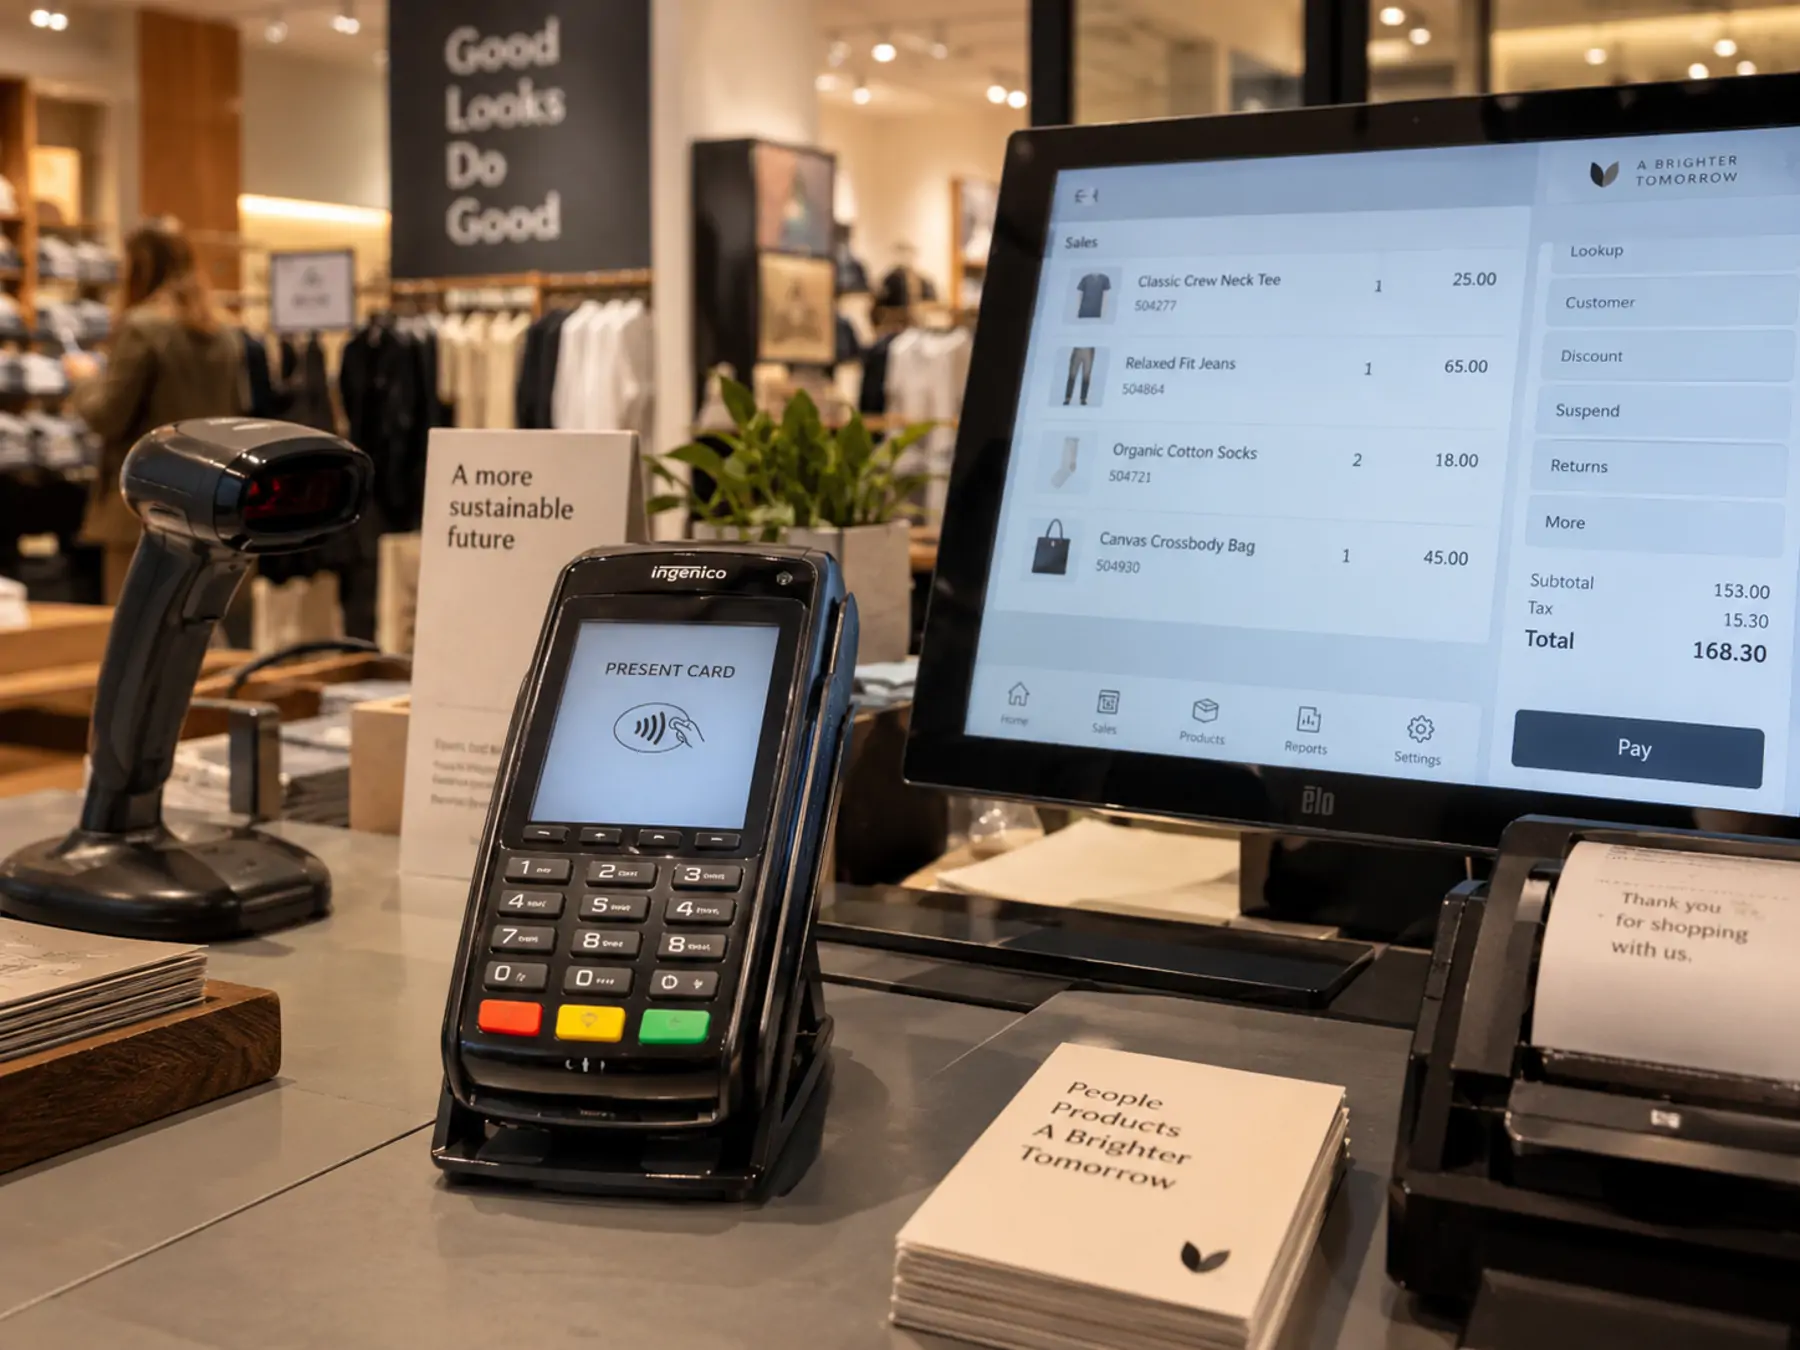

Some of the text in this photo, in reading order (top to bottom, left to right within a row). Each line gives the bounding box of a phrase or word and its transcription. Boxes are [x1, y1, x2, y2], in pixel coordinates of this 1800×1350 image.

[444, 15, 560, 76] Good
[446, 78, 567, 134] Looks
[446, 142, 507, 189] Do
[1636, 155, 1738, 170] A BRIGHTER
[1636, 172, 1739, 187] TOMORROW
[446, 190, 560, 246] Good
[1065, 236, 1098, 249] Sales
[1570, 245, 1624, 259] Lookup
[1138, 272, 1498, 293] Classic Crew Neck Tee 1 25.00
[1134, 300, 1177, 312] 504277
[1565, 296, 1636, 310] Customer
[1560, 349, 1623, 364] Discount
[1125, 356, 1489, 376] Relaxed Fit Jeans 1 65.00
[1122, 382, 1165, 395] 504864
[1556, 403, 1620, 420] Suspend
[1113, 443, 1479, 468] Organic Cotton Socks 2 18.00
[1551, 459, 1608, 473] Returns
[452, 464, 533, 487] A more
[1109, 469, 1151, 483] 504721
[449, 498, 574, 521] sustainable
[1545, 515, 1586, 530] More
[448, 526, 515, 550] future
[1100, 532, 1469, 566] Canvas Crossbody Bag 1 45.00
[651, 565, 727, 582] ingenico
[1096, 559, 1140, 574] 504930
[1530, 573, 1770, 599] Subtotal 153.00
[1528, 600, 1769, 629] Tax 15.30
[1525, 630, 1767, 664] Total 168.30
[605, 662, 735, 679] PRESENT CARD
[1092, 722, 1117, 735] Sales
[1179, 731, 1225, 746] Products
[1284, 741, 1328, 756] Reports
[1394, 750, 1442, 768] Settings
[1618, 738, 1652, 761] Pay
[521, 860, 530, 875] 1
[599, 864, 616, 878] 2
[684, 867, 702, 882] 3
[508, 893, 524, 909] 4
[676, 901, 693, 916] 4
[1622, 891, 1722, 915] Thank you
[502, 928, 518, 944] 7
[1615, 913, 1749, 945] for shopping
[583, 932, 600, 948] 8
[668, 936, 686, 952] 8
[1611, 939, 1693, 963] with us.
[1067, 1081, 1163, 1111] People
[1051, 1101, 1181, 1138] Products
[1032, 1124, 1192, 1166] A Brighter
[1020, 1145, 1176, 1190] Tomorrow
